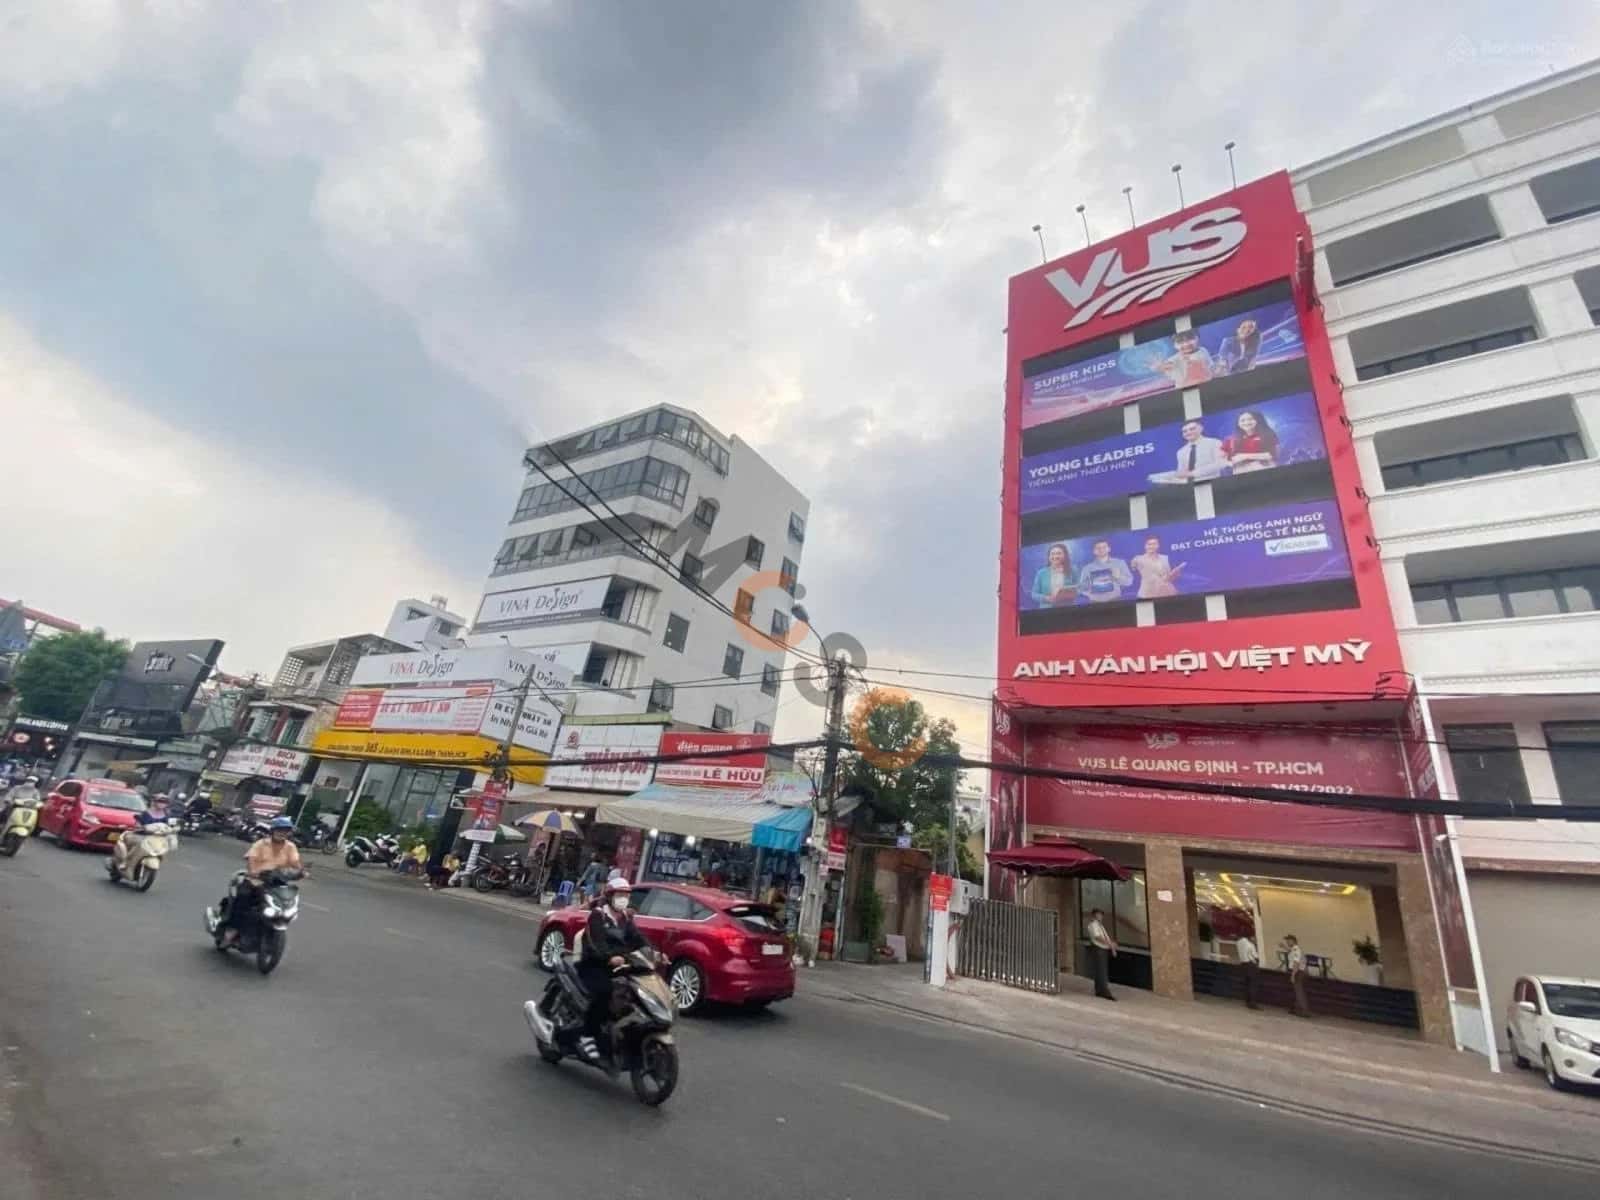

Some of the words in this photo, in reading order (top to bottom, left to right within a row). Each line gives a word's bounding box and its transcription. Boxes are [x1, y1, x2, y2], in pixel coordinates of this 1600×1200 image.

[1044, 206, 1247, 312] VUS
[1034, 369, 1079, 390] SUPER
[1083, 359, 1117, 379] KIDS
[1028, 458, 1081, 479] YOUNG
[1084, 442, 1155, 467] LEADERS
[1265, 516, 1291, 529] ANH
[1292, 522, 1325, 534] NEAS
[500, 598, 529, 613] VINA
[1012, 660, 1075, 677] ANH
[1079, 653, 1146, 675] VĂN
[1149, 648, 1208, 676] HỘI
[1211, 644, 1296, 673] VIỆT
[1303, 637, 1372, 665] MỸ
[390, 661, 415, 675] VINA
[508, 659, 529, 674] VIN
[1078, 756, 1107, 769] VUS
[1110, 755, 1129, 770] LÊ
[1131, 759, 1190, 772] QUANG
[1194, 760, 1238, 776] ĐỊNH
[1254, 761, 1324, 775] TP.HCM
